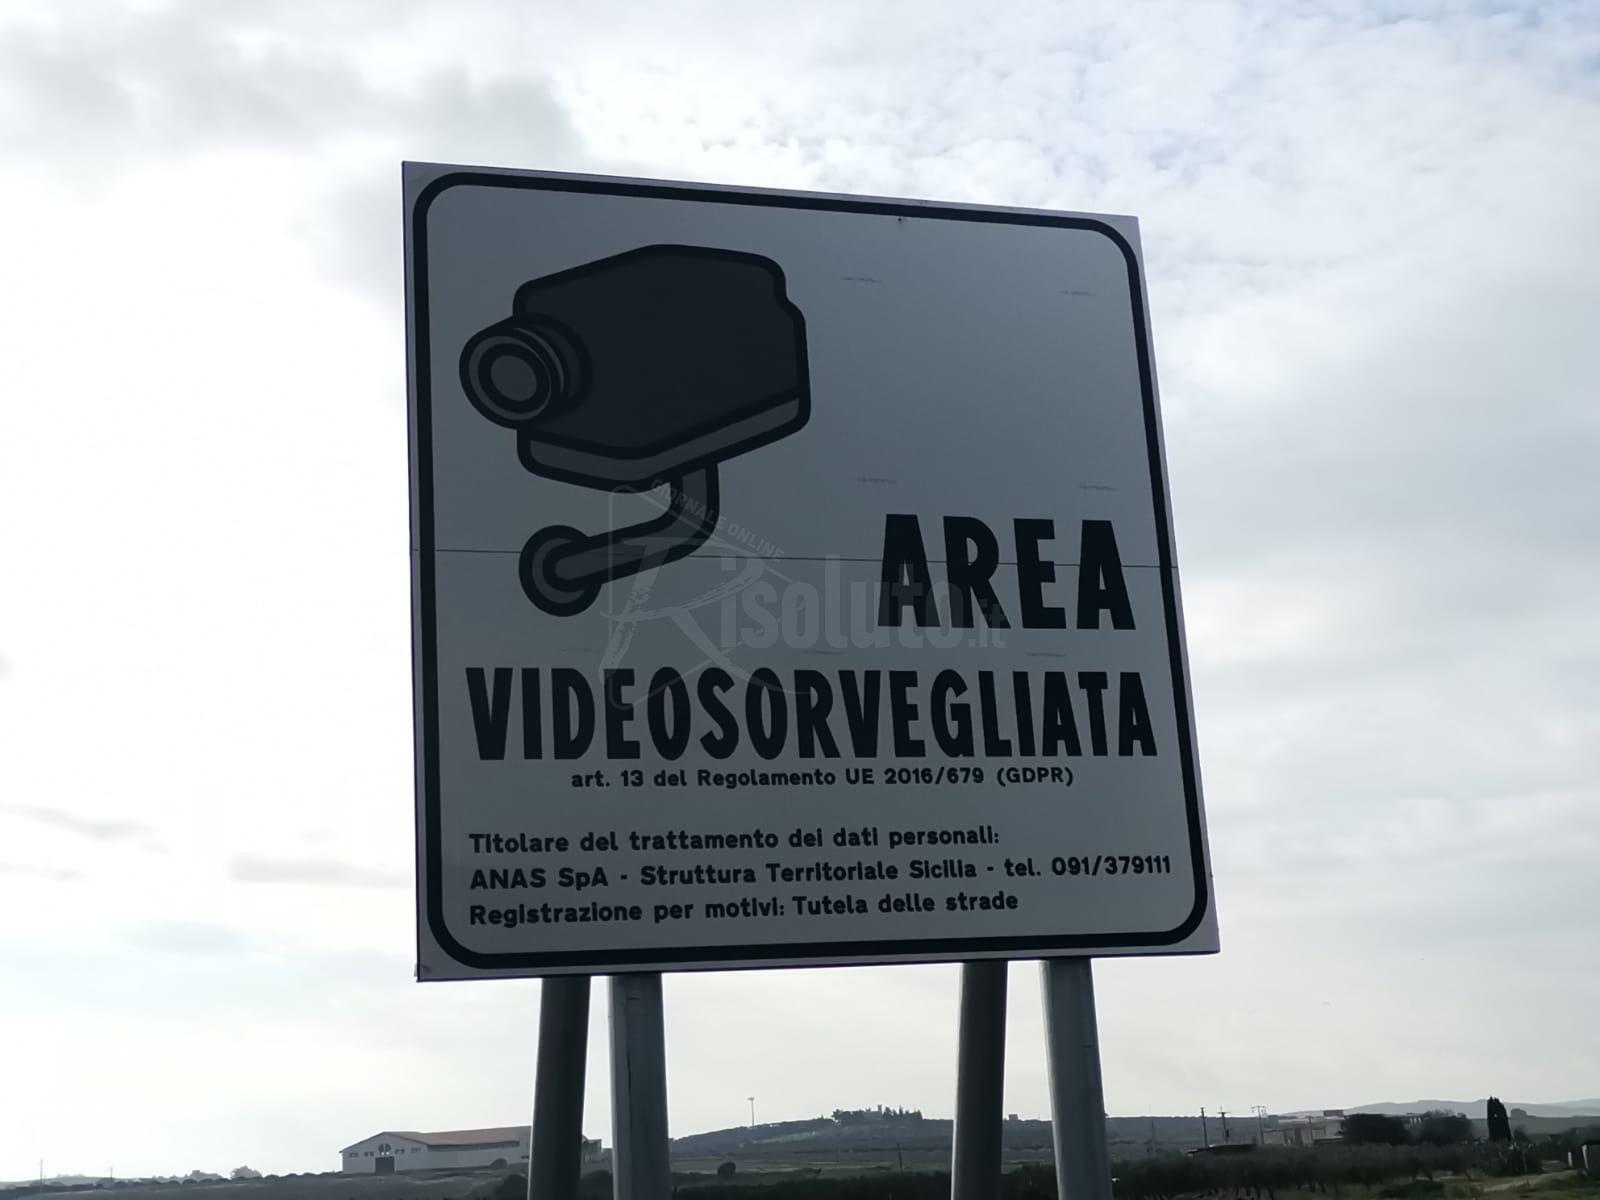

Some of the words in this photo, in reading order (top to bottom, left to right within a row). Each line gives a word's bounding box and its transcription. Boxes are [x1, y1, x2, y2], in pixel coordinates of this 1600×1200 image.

[877, 513, 1137, 631] AREA
[465, 666, 1158, 761] VIDEOSORVEGLIATA
[571, 769, 611, 788] art.
[620, 769, 644, 788] 13
[653, 769, 688, 787] del
[697, 767, 837, 790] Regolamento
[845, 767, 875, 785] UE
[883, 766, 985, 785] 2016/679
[996, 766, 1074, 788] (GDPR)
[469, 832, 570, 854] Titolare
[579, 831, 619, 852] del
[628, 828, 779, 851] trattamento
[788, 827, 823, 848] dei
[832, 826, 879, 847] dati
[888, 824, 1000, 850] personali:
[469, 867, 547, 891] ANAS
[557, 866, 609, 892] SpA
[639, 864, 757, 886] Struttura
[765, 860, 899, 883] Territoriale
[908, 858, 977, 879] Sicilia
[1003, 857, 1042, 877] tel.
[1051, 855, 1171, 877] 091/379111
[469, 901, 643, 929] Registrazione
[653, 903, 695, 924] per
[704, 896, 785, 919] motivi:
[791, 894, 869, 916] Tutela
[877, 892, 936, 914] delle
[945, 890, 1019, 912] strade
